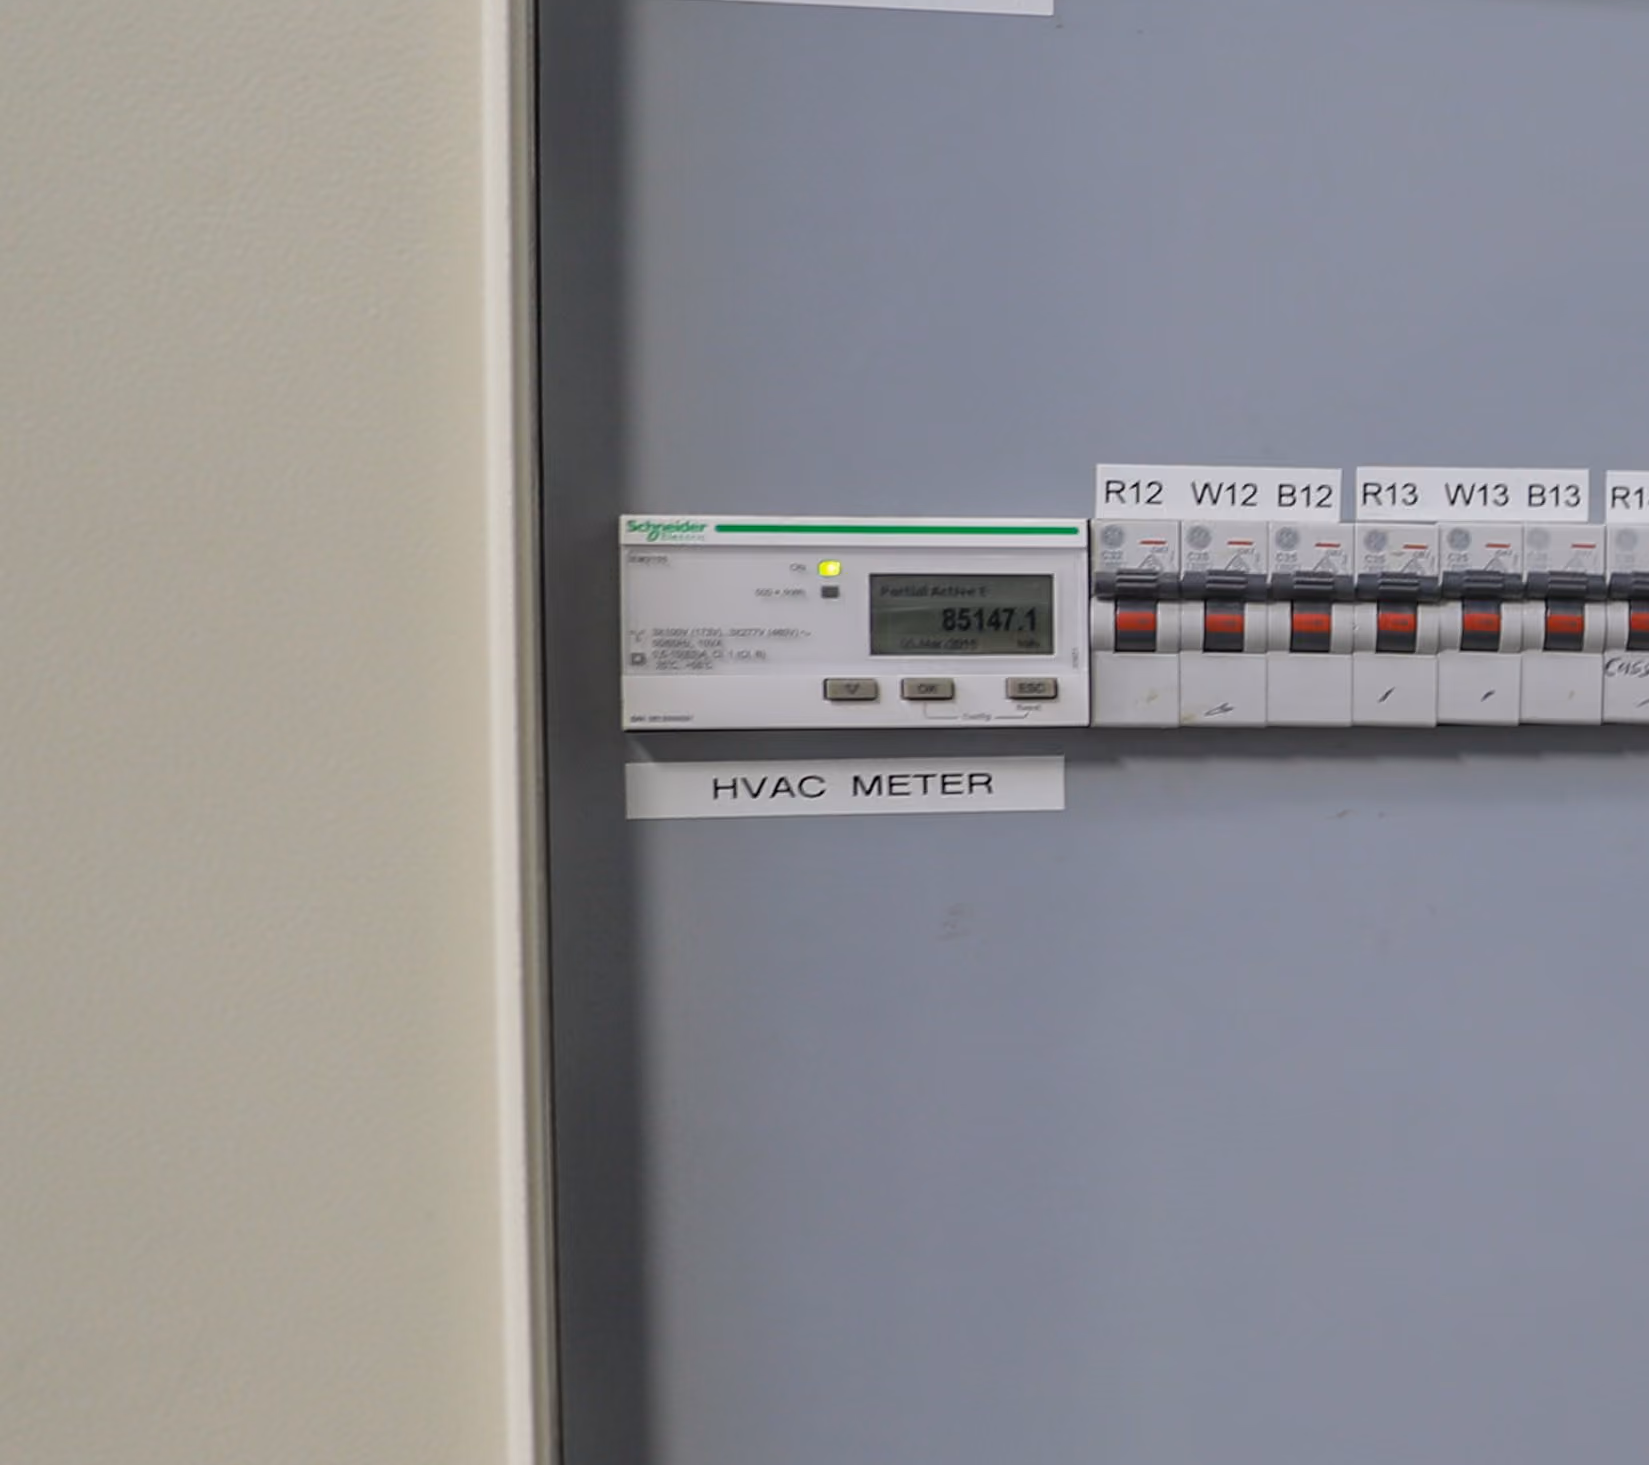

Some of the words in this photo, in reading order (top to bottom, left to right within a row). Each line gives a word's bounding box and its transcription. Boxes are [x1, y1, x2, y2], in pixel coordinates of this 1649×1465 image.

[1105, 479, 1163, 505] R12
[1191, 482, 1258, 507] W12
[1277, 483, 1333, 508] B12
[1362, 482, 1419, 506] R13
[1444, 483, 1510, 507] W13
[1527, 483, 1581, 508] B13
[626, 520, 707, 542] Schneider
[942, 607, 1037, 632] 85147.1
[1018, 682, 1046, 693] ESC
[713, 775, 826, 800] HVAC
[852, 772, 993, 797] METER
